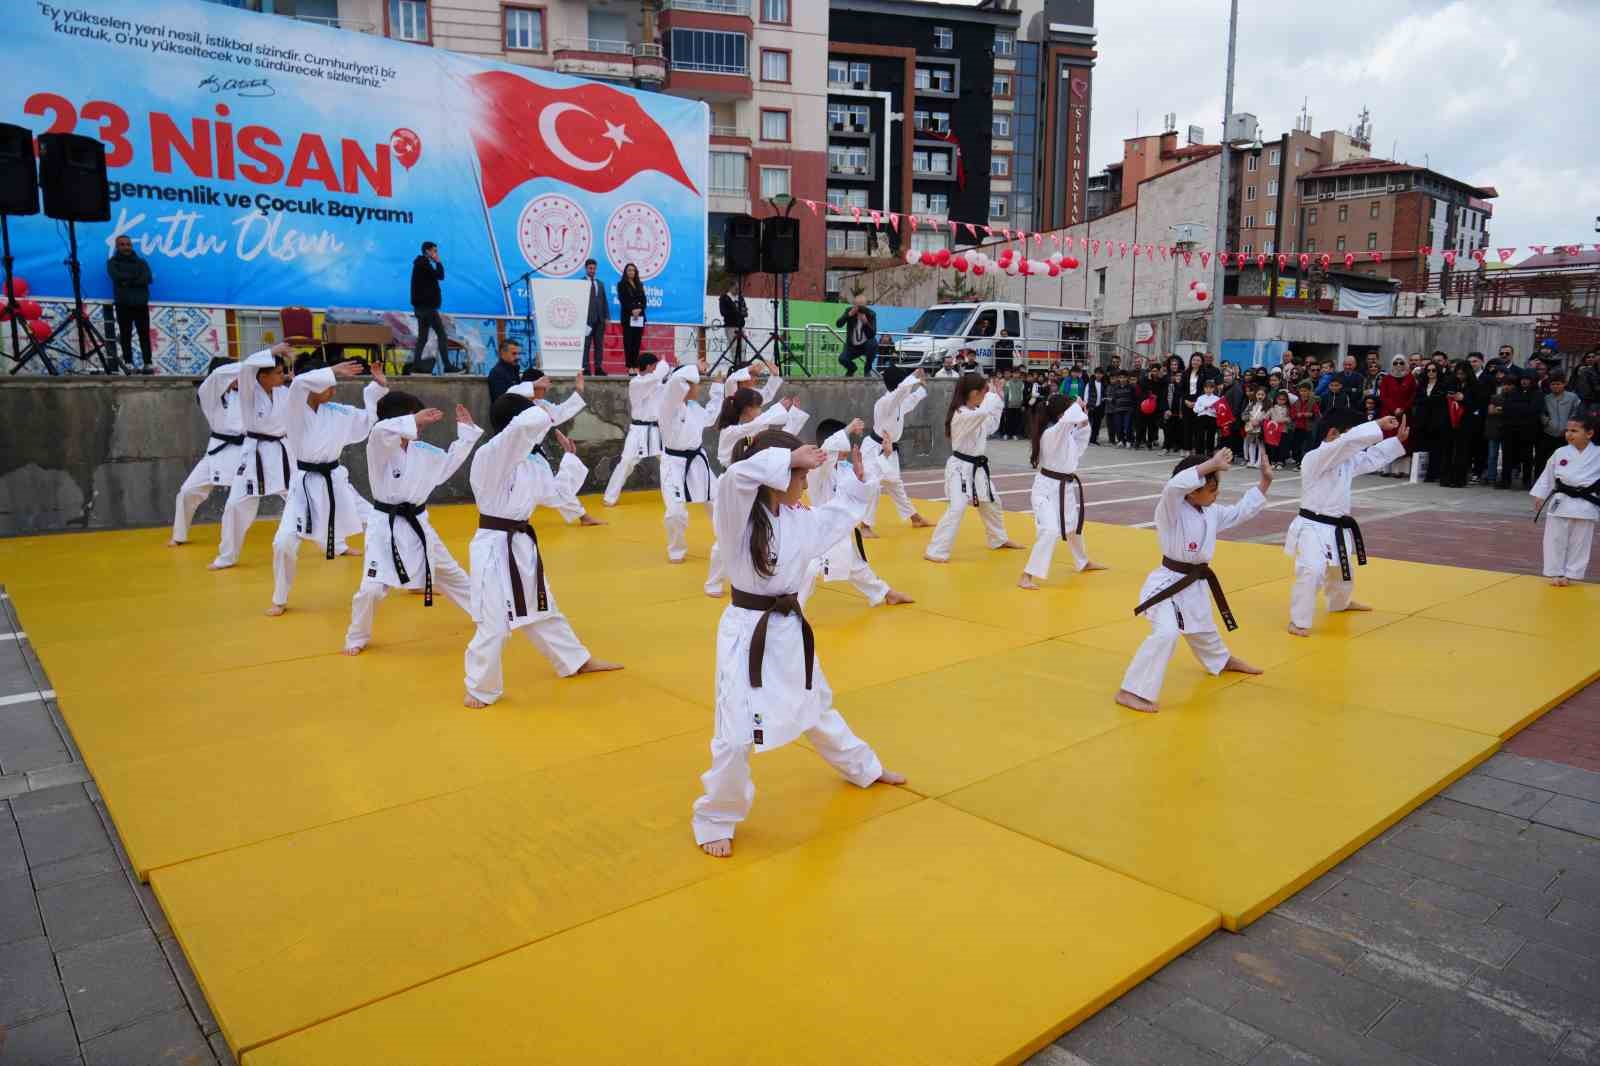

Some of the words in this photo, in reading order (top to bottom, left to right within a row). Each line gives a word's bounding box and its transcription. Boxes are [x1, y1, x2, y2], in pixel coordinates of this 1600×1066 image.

[54, 20, 112, 43] kurduk,
[115, 32, 149, 48] O'nu
[151, 39, 233, 63] yükseltecek
[235, 55, 252, 66] ve
[254, 57, 325, 79] sürdürecek
[63, 8, 132, 31] yükselen
[135, 23, 165, 36] yeni
[167, 29, 203, 45] nesil,
[205, 33, 253, 53] istikbal
[255, 44, 301, 60] sizindir.
[304, 53, 379, 76] Cumhuriyet'i
[381, 66, 397, 79] biz
[23, 92, 134, 168] 23
[148, 102, 393, 198] NİSAN
[106, 207, 229, 258] Kutlu
[231, 211, 345, 262] Olsun
[223, 190, 251, 208] ve
[254, 193, 325, 219] Çocuk
[328, 202, 414, 225] Bayramı
